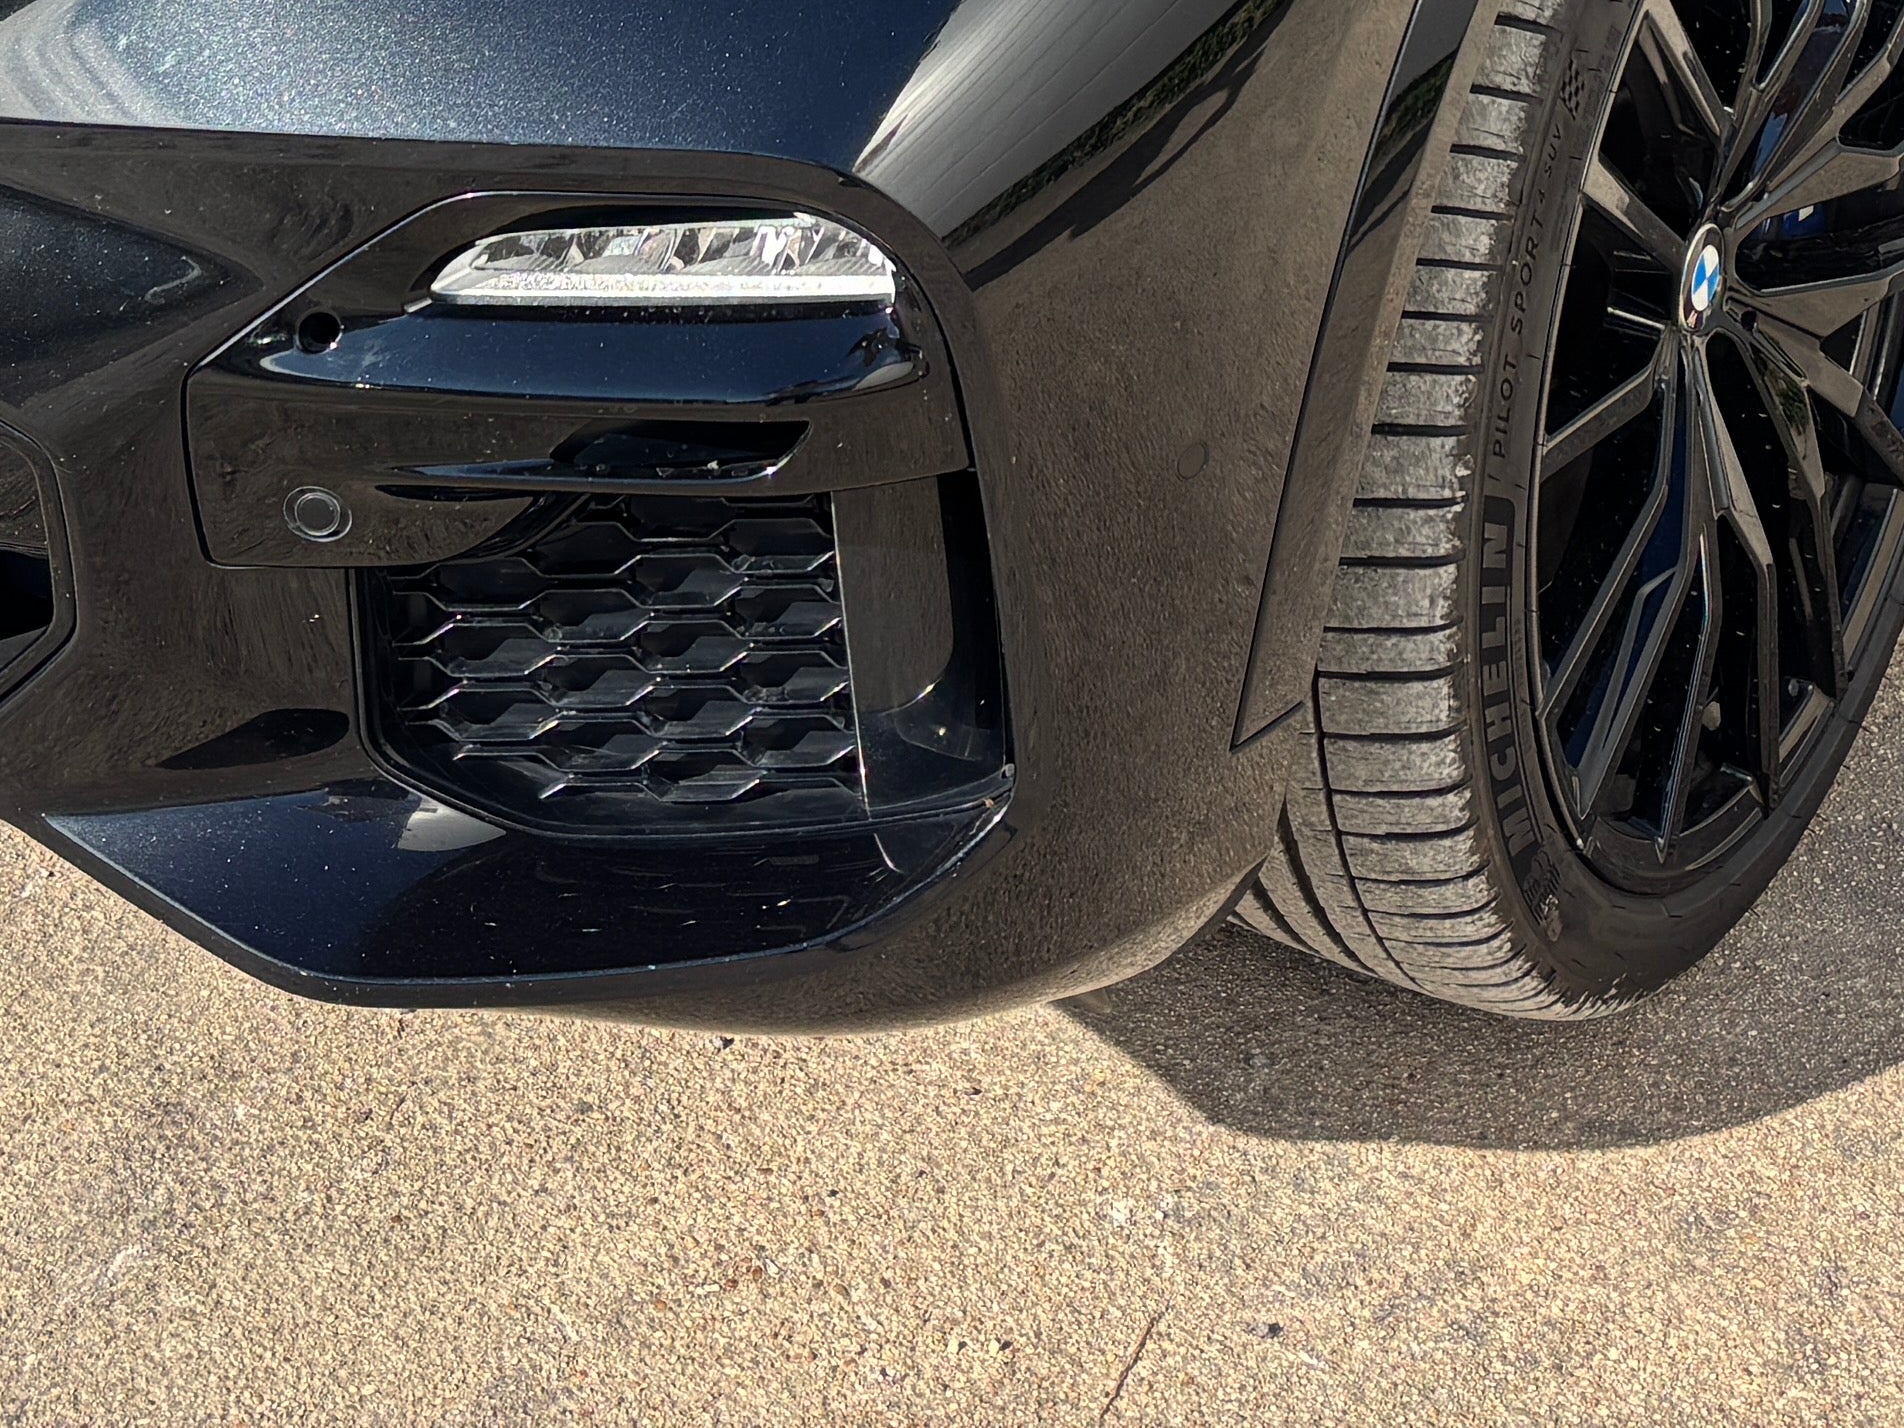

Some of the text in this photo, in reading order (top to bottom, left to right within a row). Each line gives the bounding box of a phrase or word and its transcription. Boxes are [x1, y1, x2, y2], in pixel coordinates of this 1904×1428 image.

[1493, 353, 1518, 459] PILOT
[1510, 211, 1547, 336] SPORT
[1543, 123, 1562, 179] SUV
[1482, 523, 1537, 858] MICHELIN
